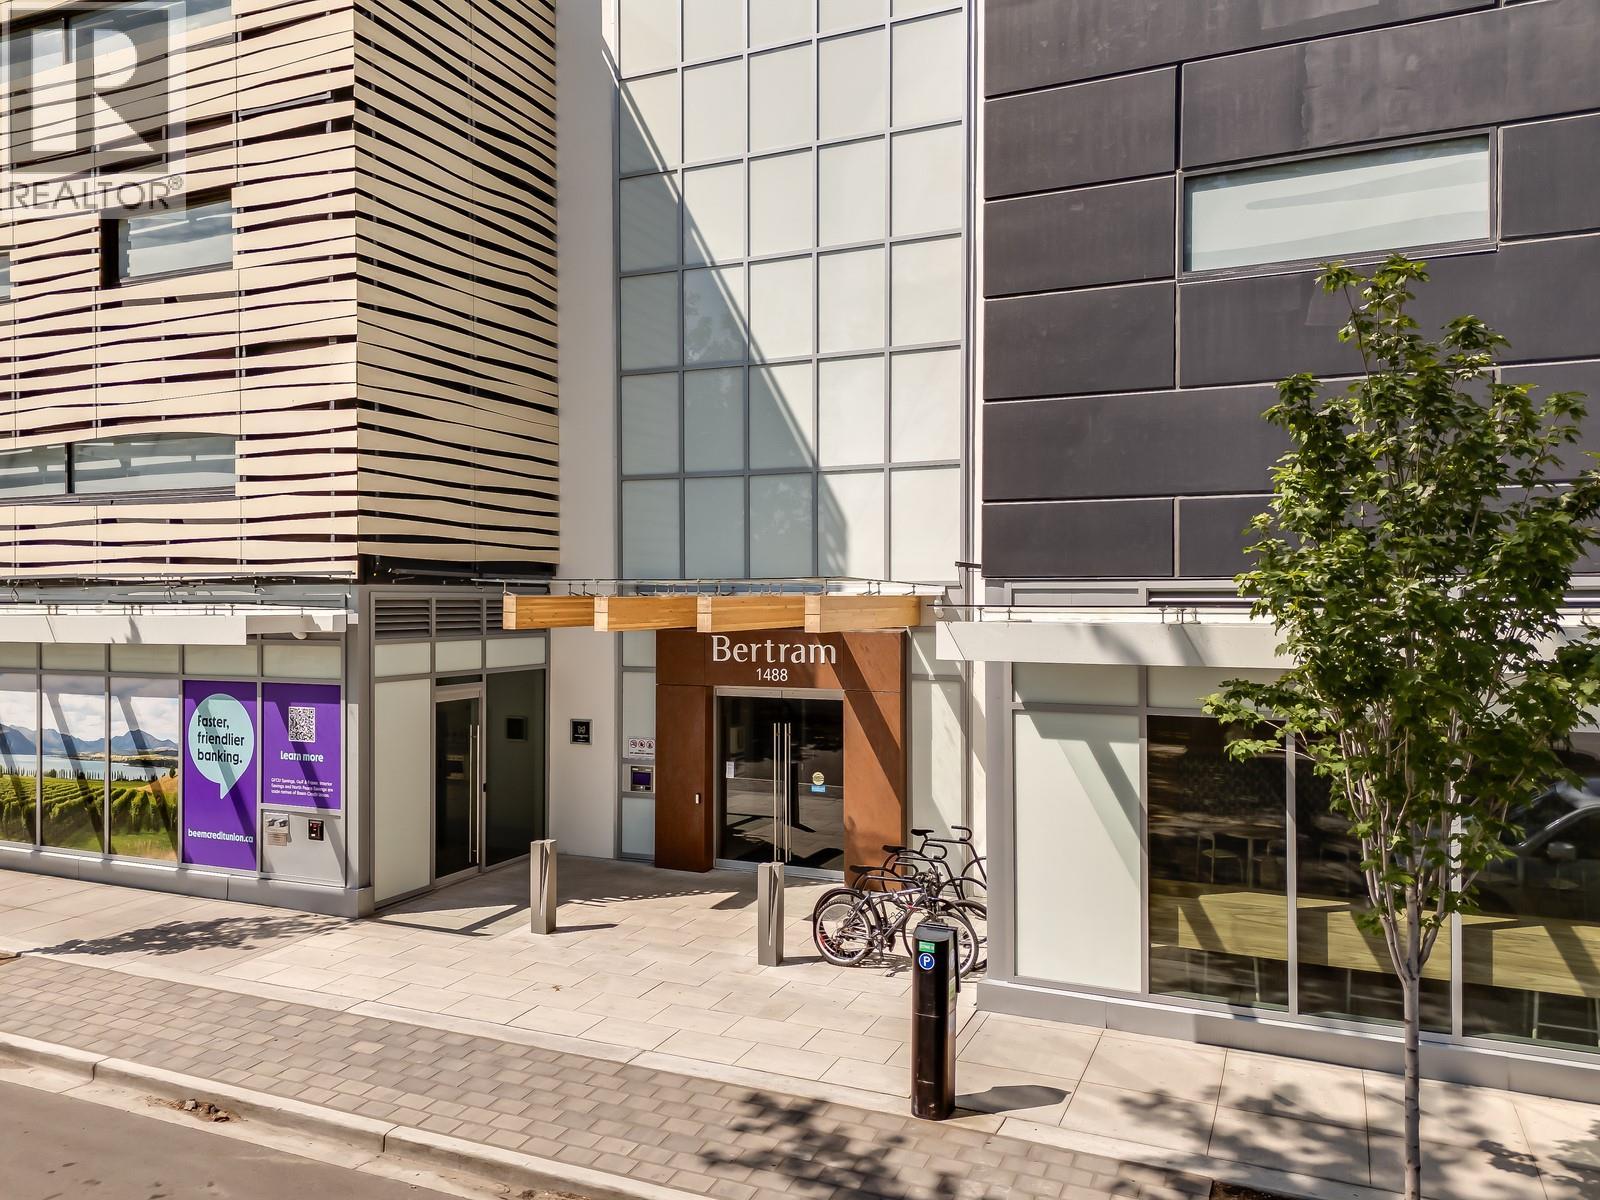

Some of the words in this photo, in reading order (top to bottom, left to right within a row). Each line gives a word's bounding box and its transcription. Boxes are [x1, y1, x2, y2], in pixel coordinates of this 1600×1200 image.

[711, 635, 837, 664] Bertram
[756, 667, 788, 682] 1488
[197, 714, 230, 730] Faster,
[197, 731, 245, 746] friendlier
[197, 748, 243, 765] banking.
[280, 750, 302, 761] Learn
[302, 753, 324, 763] more
[187, 828, 254, 842] beemcreditunion.ca
[923, 956, 931, 967] P
